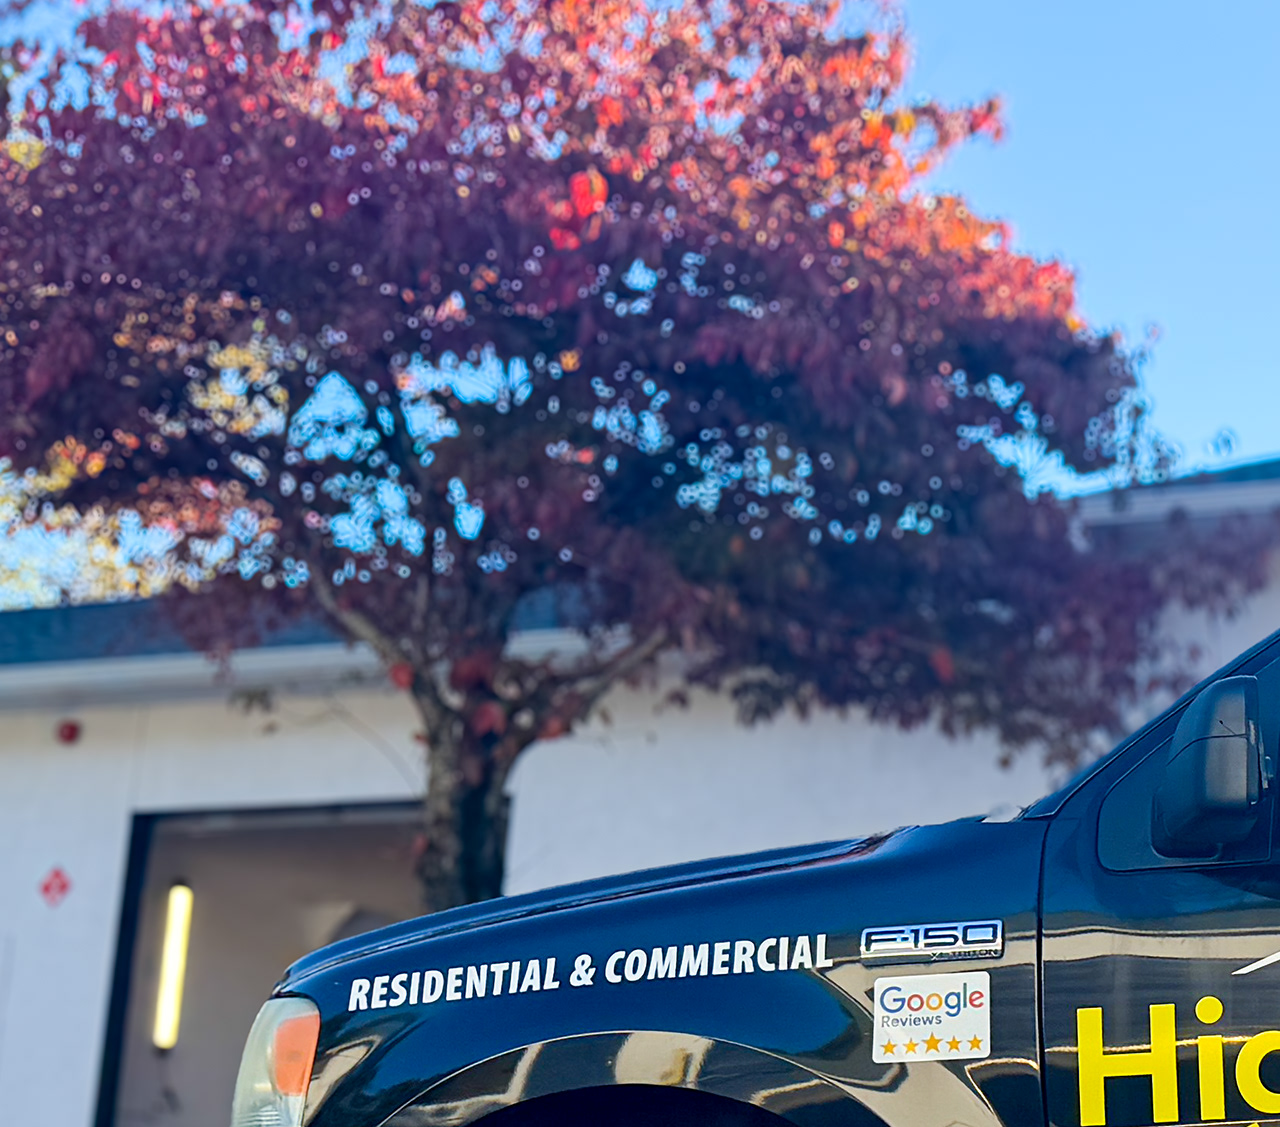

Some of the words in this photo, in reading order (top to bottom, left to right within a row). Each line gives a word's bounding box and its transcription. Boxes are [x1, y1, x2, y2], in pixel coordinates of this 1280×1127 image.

[864, 923, 999, 952] F-150
[348, 957, 560, 1012] RESIDENTIAL
[569, 954, 596, 987] &
[605, 934, 834, 983] COMMERCIAL
[879, 982, 985, 1018] Google
[881, 1014, 943, 1028] Reviews
